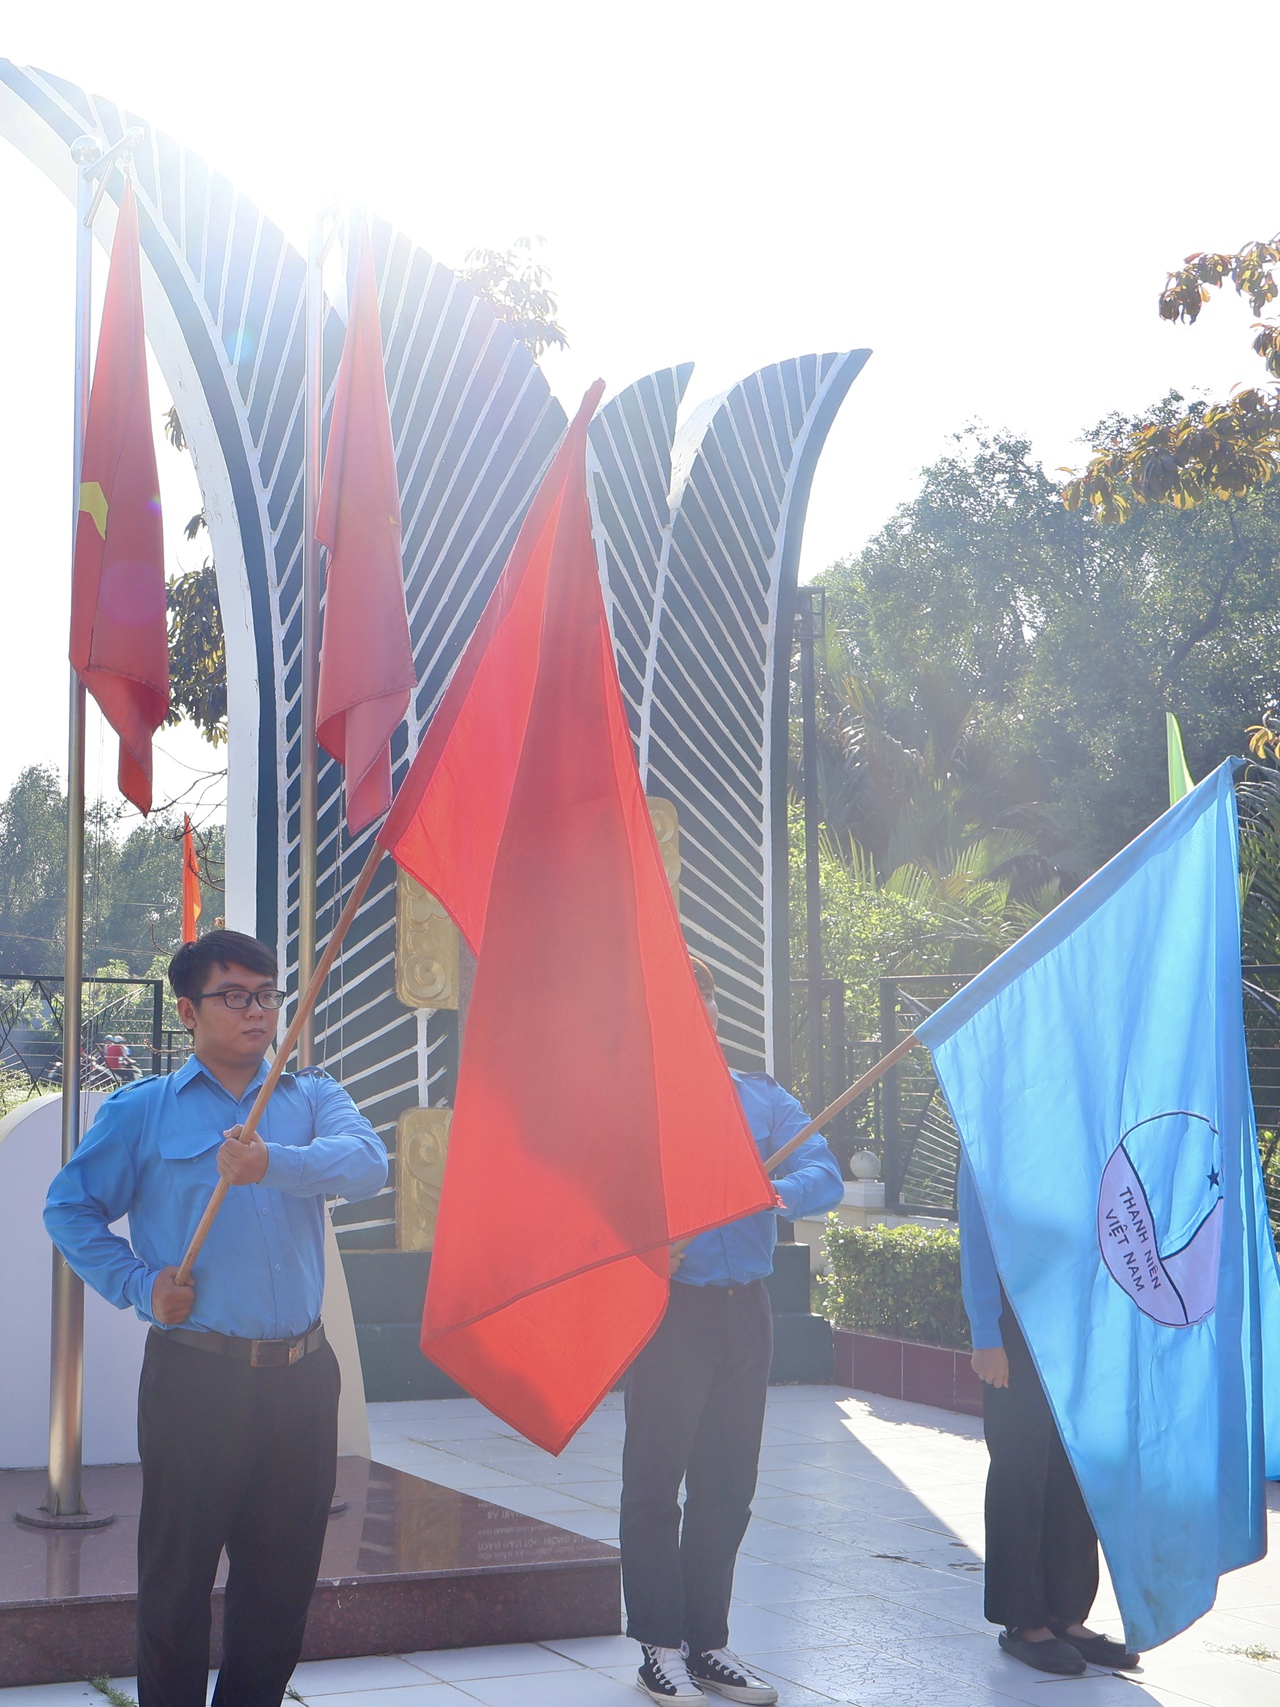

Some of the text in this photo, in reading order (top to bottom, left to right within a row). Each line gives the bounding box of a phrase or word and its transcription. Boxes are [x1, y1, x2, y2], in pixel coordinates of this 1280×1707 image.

[1105, 1208, 1145, 1292] VIỆT NAM
[1119, 1186, 1162, 1290] THANH NIÊN
